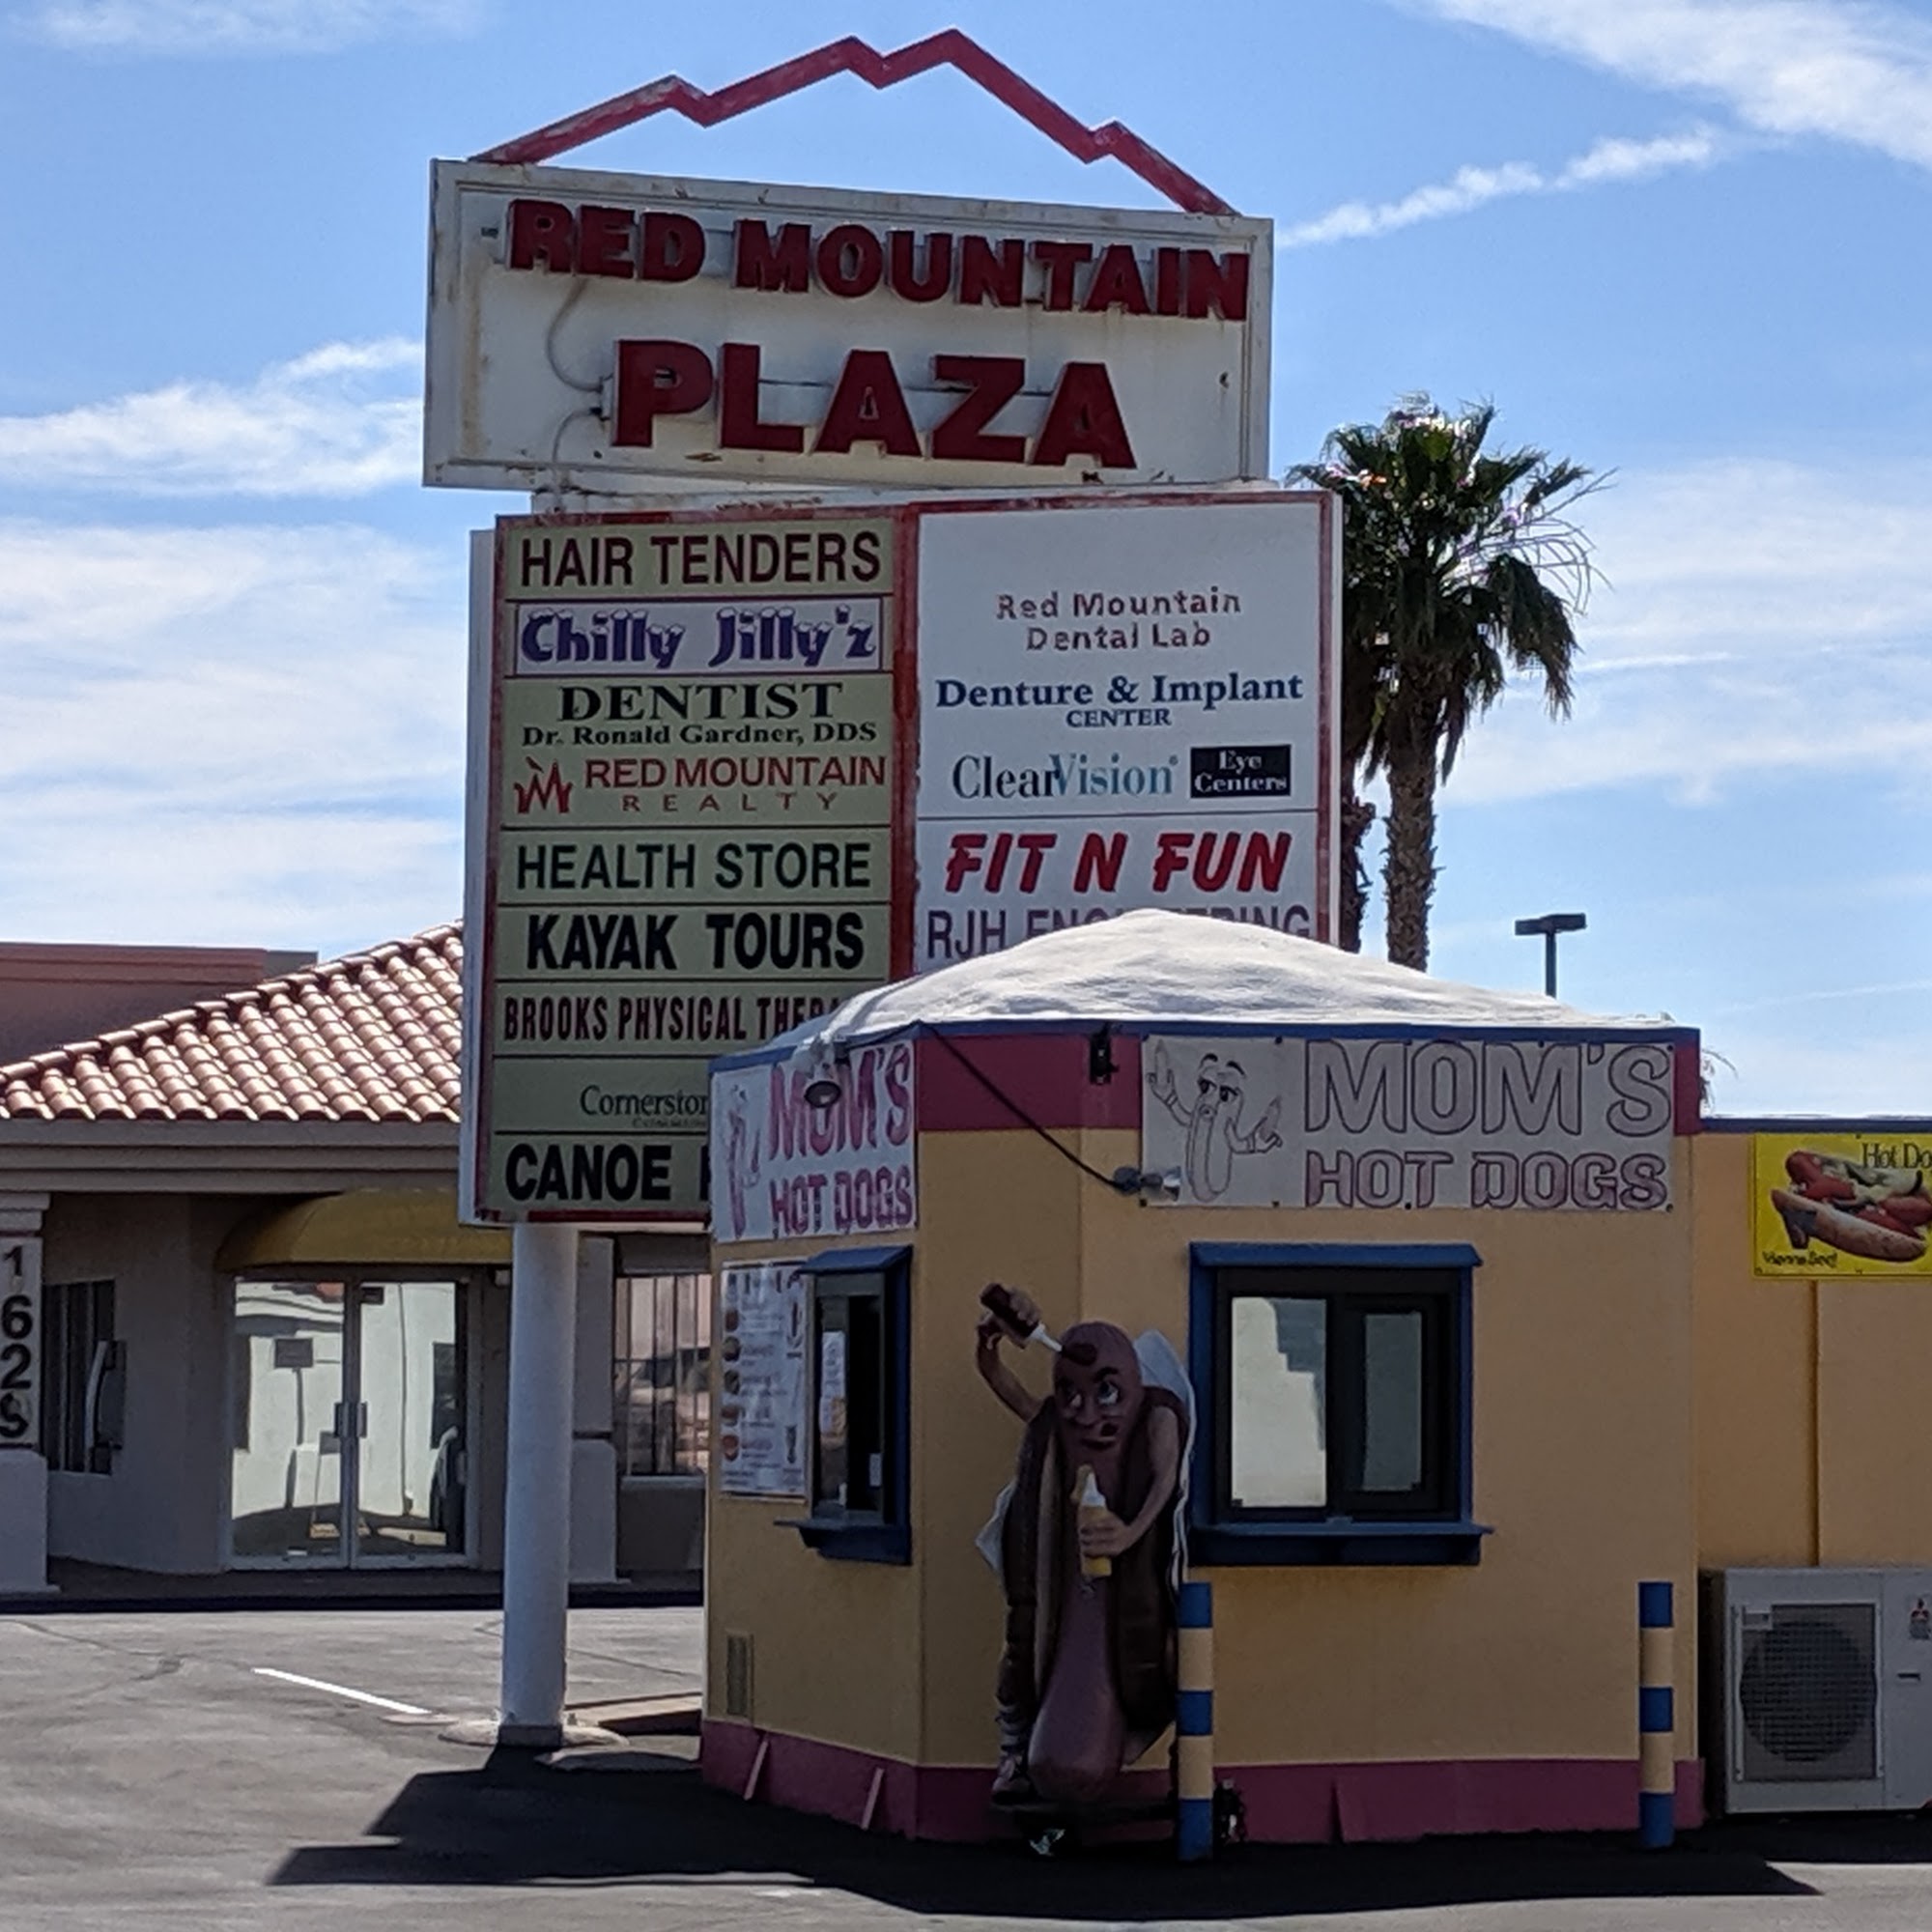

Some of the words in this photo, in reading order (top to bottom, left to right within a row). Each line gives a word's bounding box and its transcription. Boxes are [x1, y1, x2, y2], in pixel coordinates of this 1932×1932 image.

[507, 198, 706, 283] RED
[733, 218, 1250, 322] MOUNTAIN
[611, 338, 1137, 469] PLAZA
[521, 535, 634, 587] HAIR
[650, 530, 881, 585] TENDERS
[996, 592, 1059, 620] Red
[1072, 585, 1242, 618] Mountain
[521, 607, 686, 669] Chilly
[708, 603, 878, 668] Jilly'z
[1026, 623, 1139, 651] Dental
[1151, 620, 1211, 648] Lab
[557, 682, 843, 722] DENTIST
[936, 679, 1094, 707] Denture
[1107, 675, 1139, 704] &
[1151, 672, 1304, 710] Implant
[523, 726, 564, 747] Dr.
[572, 724, 671, 746] Ronald
[680, 723, 804, 747] Gardner,
[813, 722, 877, 743] DDS
[1065, 708, 1173, 728] CENTER
[584, 758, 667, 788] RED
[674, 756, 887, 787] MOUNTAIN
[1194, 773, 1288, 794] Centers
[1218, 750, 1262, 772] Eye
[623, 792, 838, 812] REALTY
[517, 843, 696, 890] HEALTH
[715, 842, 870, 889] STORE
[945, 832, 1058, 894] FIT
[1073, 832, 1128, 894] N
[1152, 831, 1293, 894] FUN
[526, 913, 678, 970] KAYAK
[705, 912, 865, 970] TOURS
[927, 910, 1007, 959] RJH
[504, 996, 608, 1041] BROOKS
[618, 996, 747, 1041] PHYSICAL
[1304, 1039, 1673, 1138] MOM'S
[504, 1143, 672, 1203] CANOE
[1862, 1143, 1896, 1169] Hot
[770, 1173, 828, 1240] HOT
[834, 1164, 913, 1236] DOGS
[1305, 1150, 1455, 1208] HOT
[1471, 1151, 1670, 1209] DOGS
